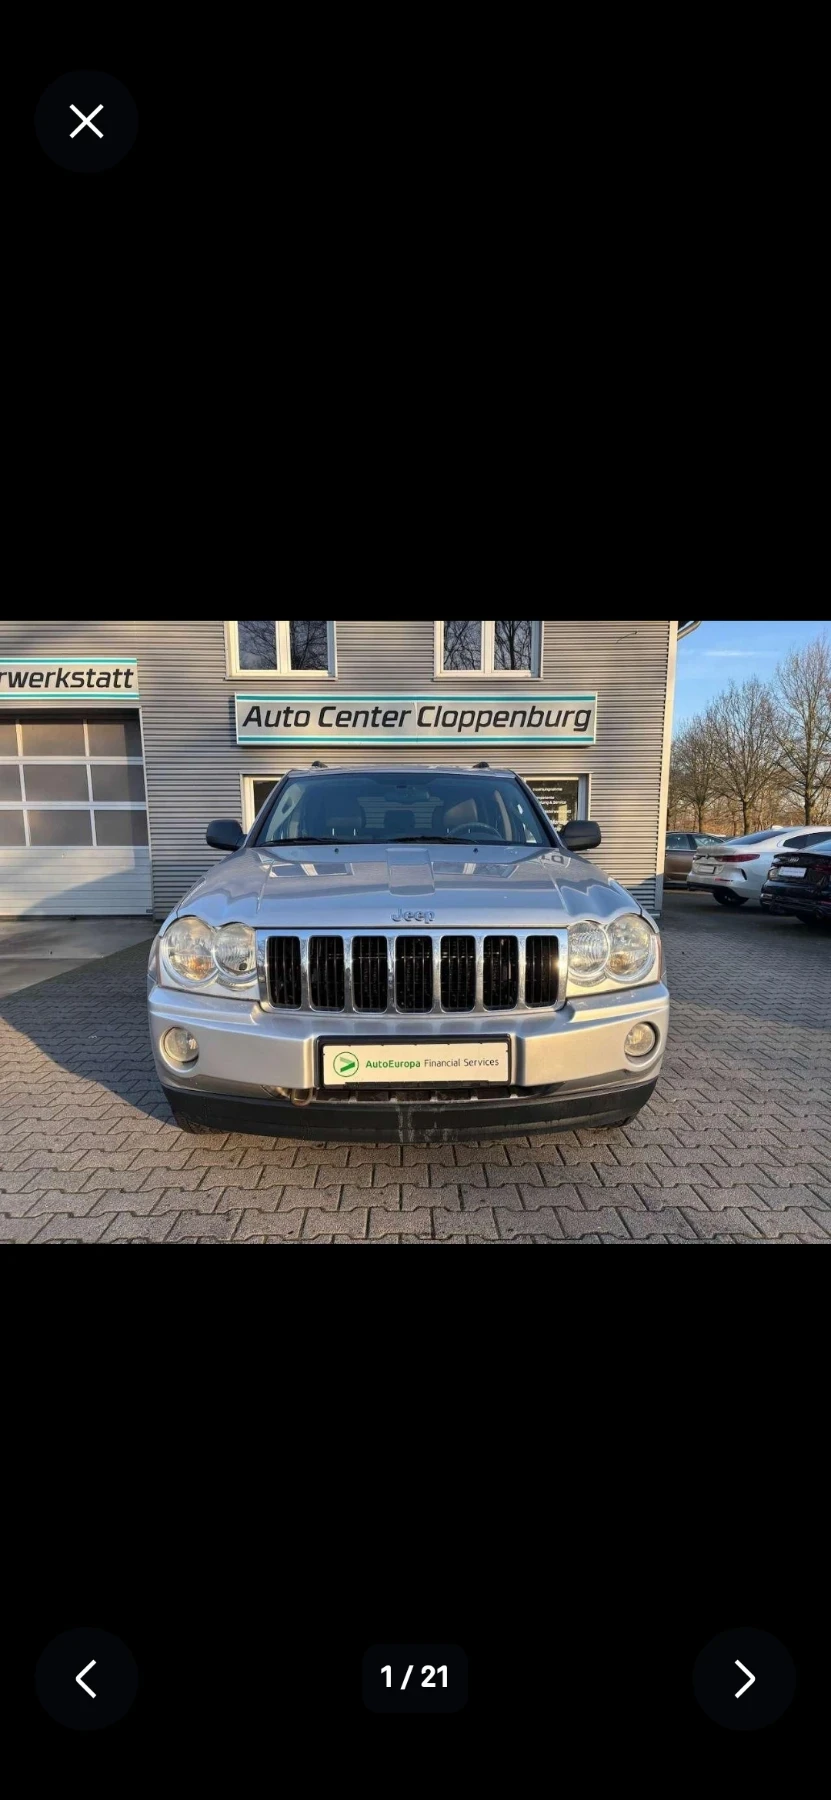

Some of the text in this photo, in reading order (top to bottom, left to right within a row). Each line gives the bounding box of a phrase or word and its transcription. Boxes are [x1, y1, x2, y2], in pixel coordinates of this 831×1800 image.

[243, 705, 591, 733] Auto Center Cloppenburg
[390, 907, 435, 924] Jeep
[366, 1058, 500, 1069] AutoEuropa Financial Services
